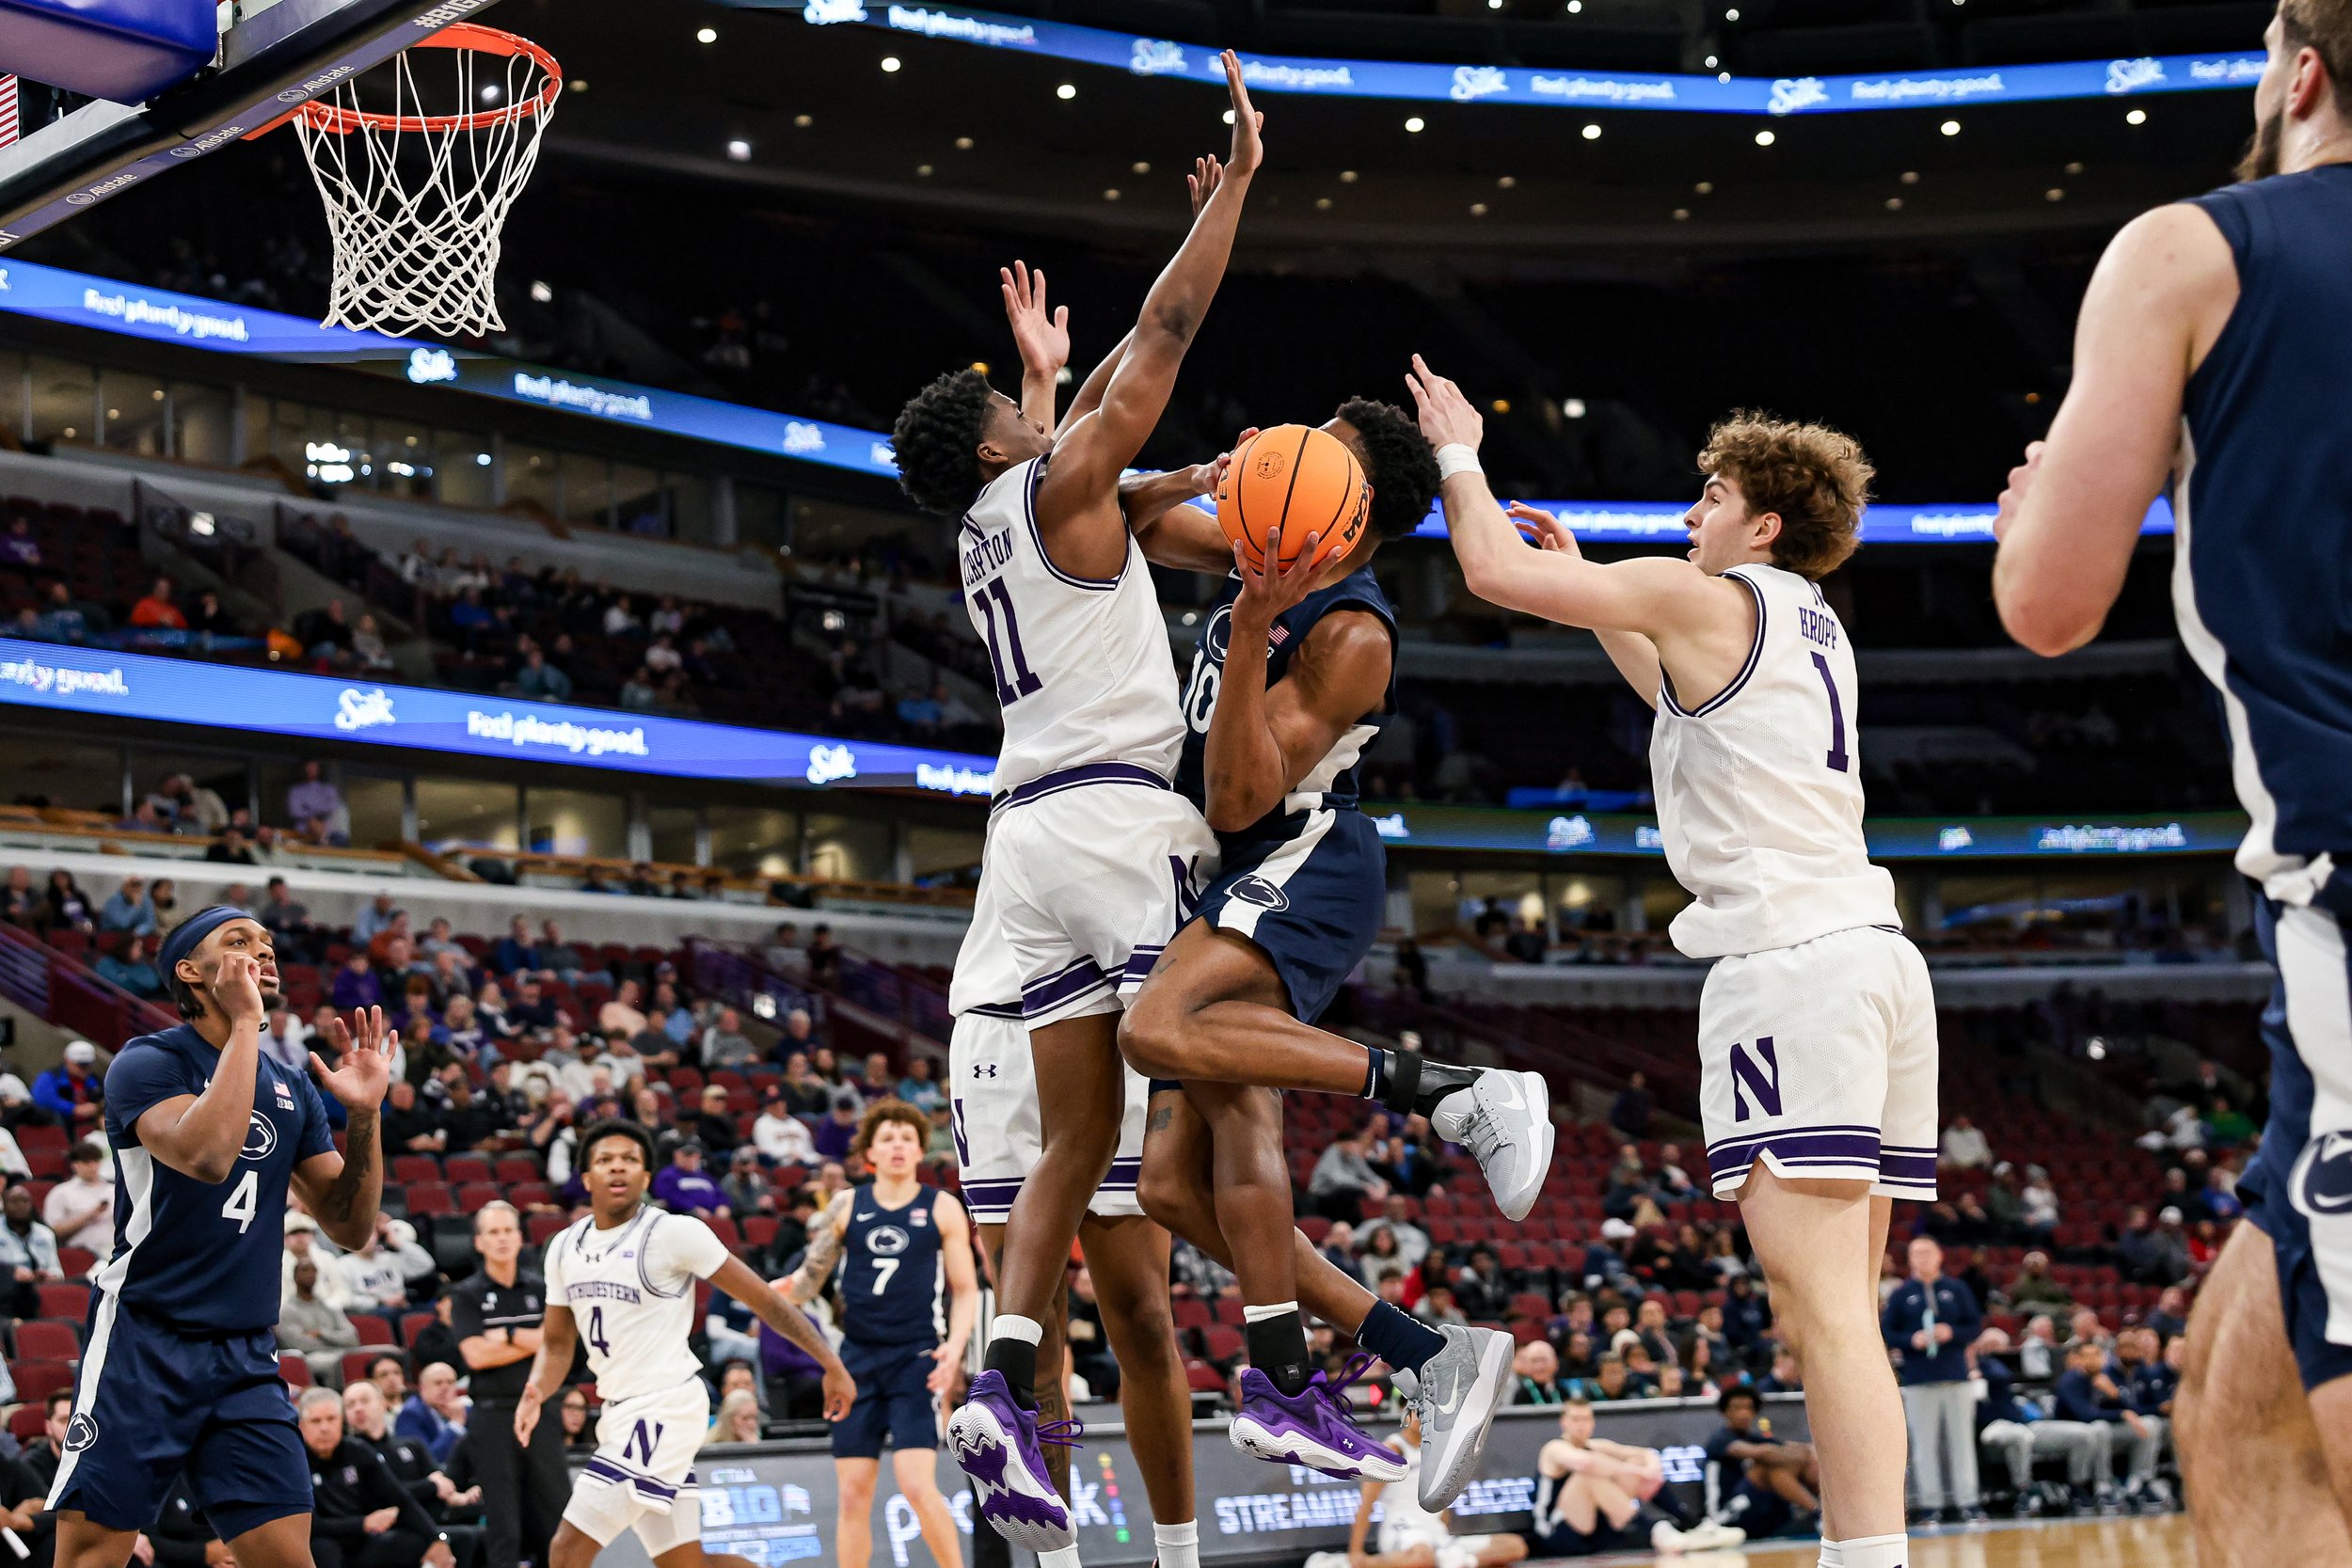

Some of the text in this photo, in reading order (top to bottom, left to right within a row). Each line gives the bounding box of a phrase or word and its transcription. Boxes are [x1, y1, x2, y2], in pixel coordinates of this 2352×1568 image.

[302, 64, 356, 92] Allstate
[195, 124, 245, 150] Allstate
[89, 172, 138, 197] Allstate
[972, 576, 1043, 707] 11
[1798, 607, 1837, 650] KROPP
[1810, 650, 1850, 773] 1
[1730, 1036, 1783, 1122] N
[221, 1171, 259, 1234] 4
[871, 1258, 900, 1296] 7
[589, 1307, 611, 1358] 4
[623, 1418, 663, 1467] N
